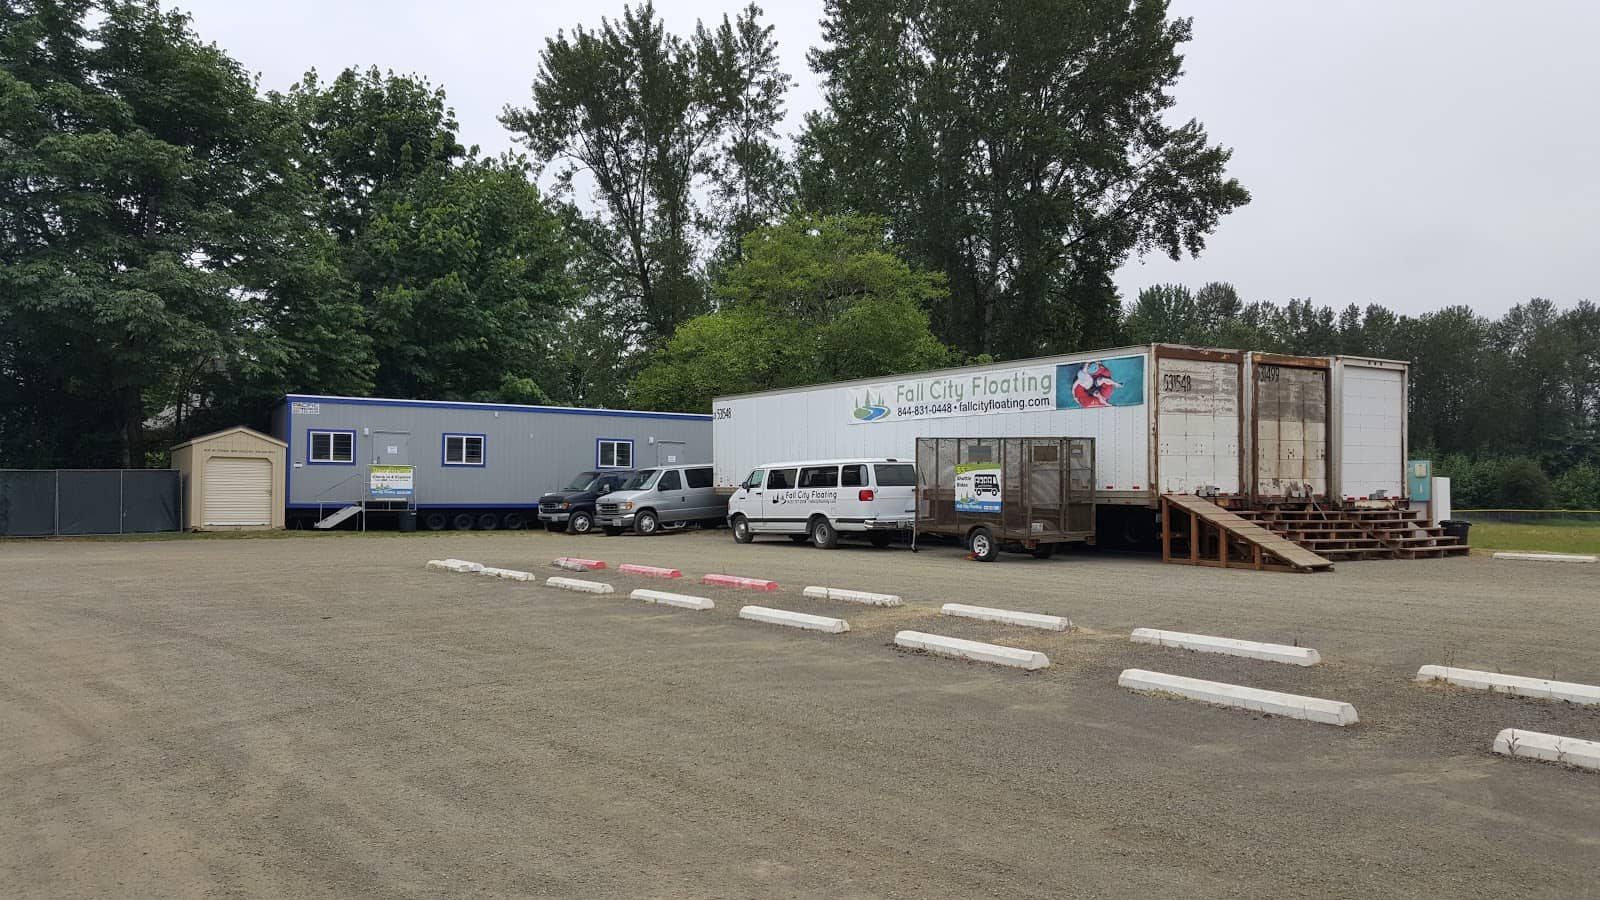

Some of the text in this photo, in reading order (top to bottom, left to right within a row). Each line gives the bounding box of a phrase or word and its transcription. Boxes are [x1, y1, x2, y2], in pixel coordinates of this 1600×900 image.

[896, 372, 1052, 402] Fall City Floating
[1163, 374, 1192, 393] 531548
[897, 396, 1050, 417] 844-831-0448 fallcityfloating.com
[785, 490, 838, 500] Fall City Floating
